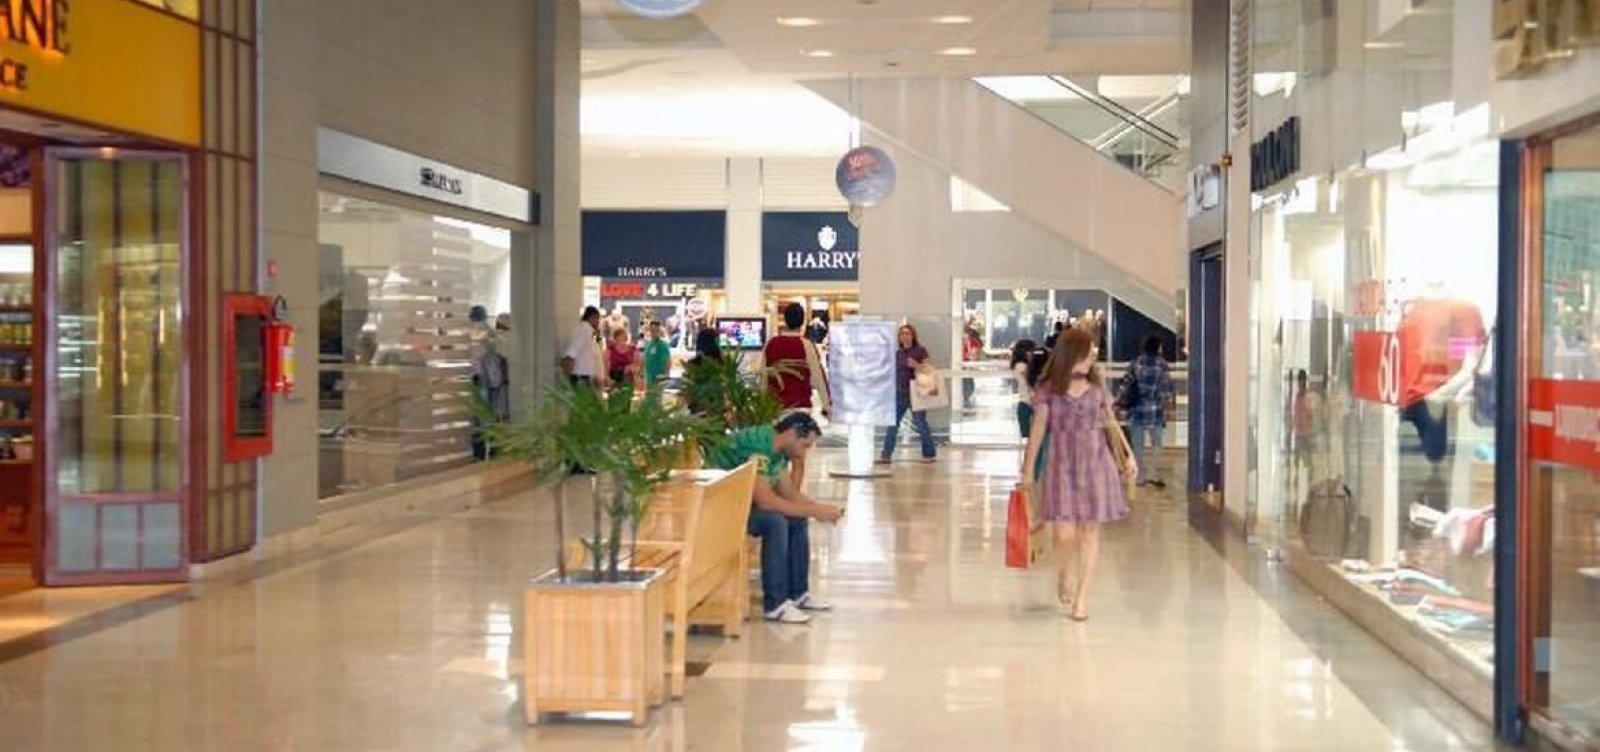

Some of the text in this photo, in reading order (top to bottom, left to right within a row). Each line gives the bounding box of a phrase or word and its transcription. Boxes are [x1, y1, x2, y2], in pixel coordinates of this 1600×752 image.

[617, 266, 667, 277] HARRY'S
[601, 281, 697, 297] LOVE 4 LIFE
[1377, 333, 1400, 404] 60
